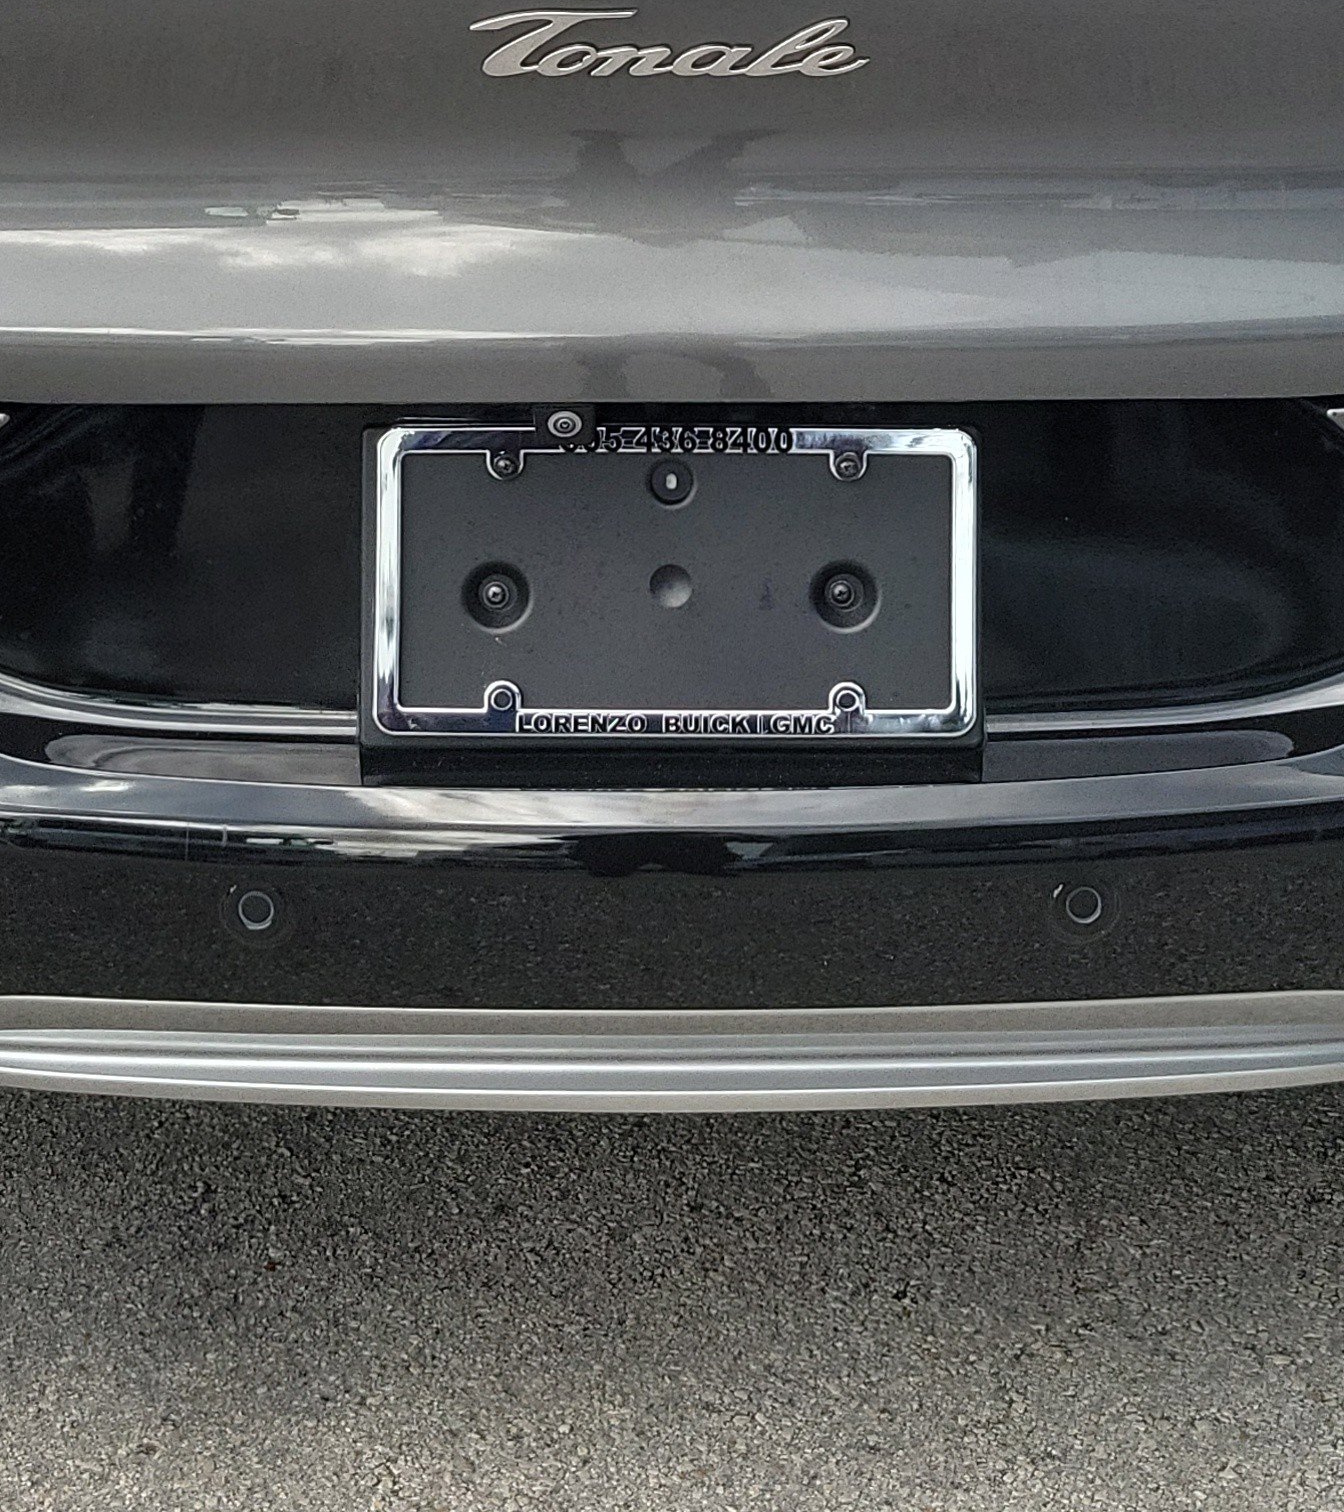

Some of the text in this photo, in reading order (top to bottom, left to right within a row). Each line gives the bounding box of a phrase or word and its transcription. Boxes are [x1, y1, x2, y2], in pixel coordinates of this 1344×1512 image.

[468, 7, 871, 78] Tonale
[516, 713, 836, 735] LORENZO BUICK GMC
